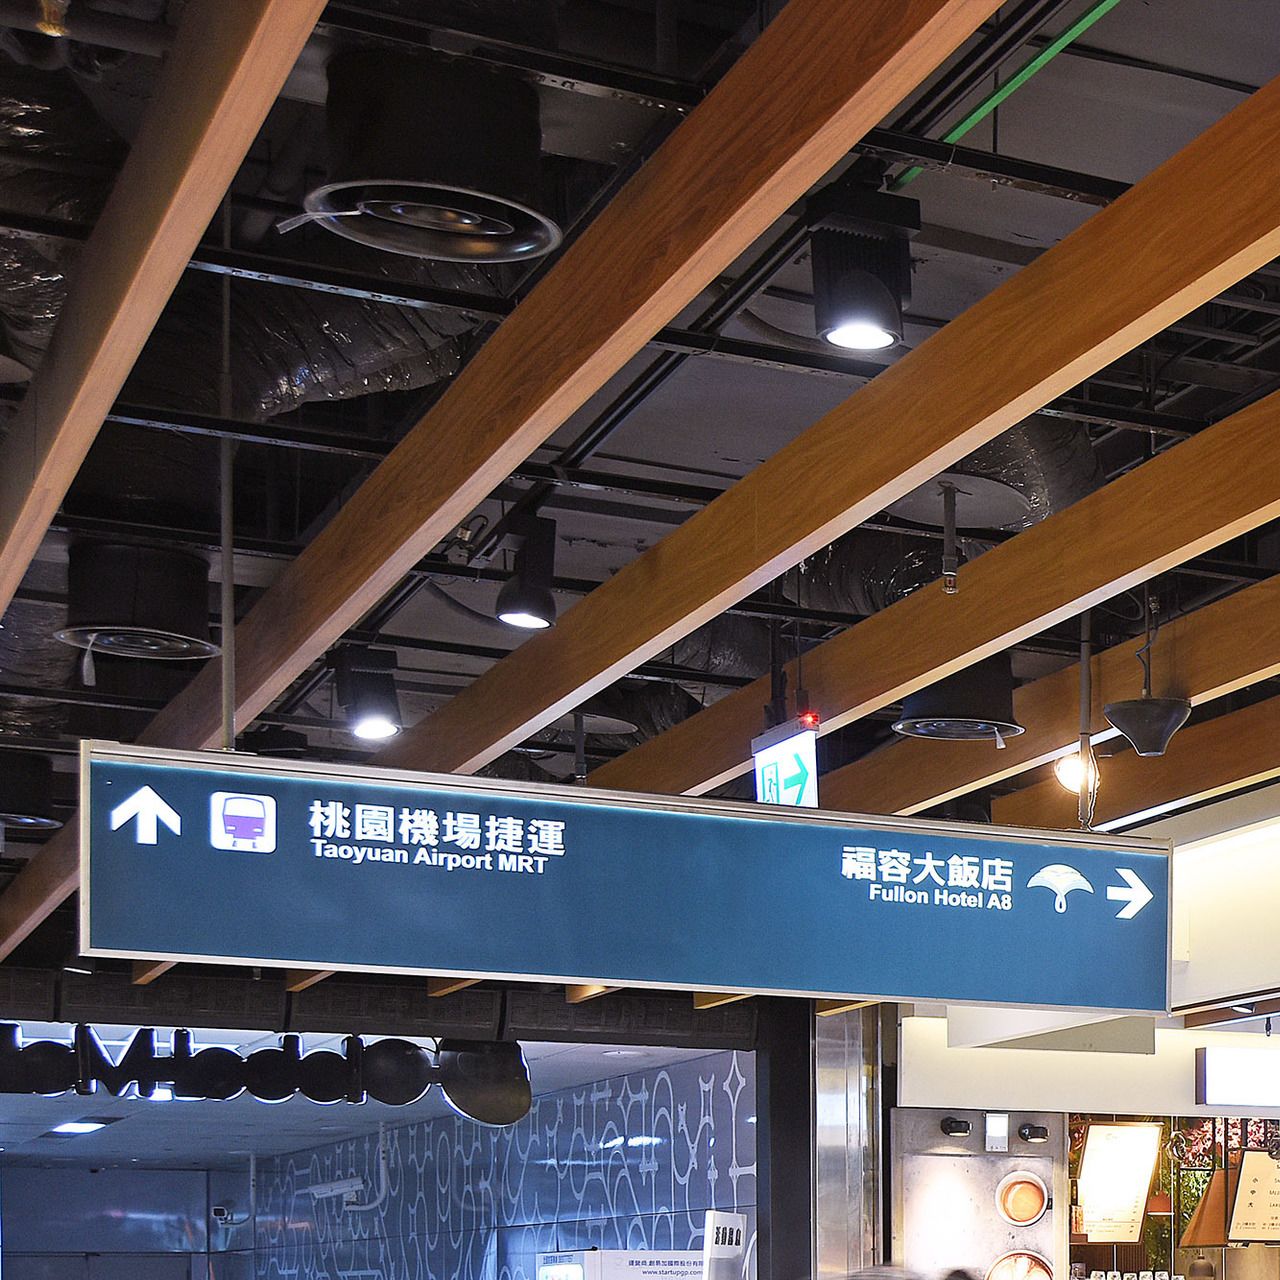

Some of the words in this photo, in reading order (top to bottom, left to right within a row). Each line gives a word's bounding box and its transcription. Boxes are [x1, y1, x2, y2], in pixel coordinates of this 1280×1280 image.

[308, 799, 567, 859] 桃園機場捷運
[311, 838, 409, 866] Taoyuan
[413, 846, 494, 874] Airport
[497, 853, 549, 875] MRT
[840, 845, 1014, 892] 福容大飯店
[868, 883, 929, 905] Fullon
[934, 887, 984, 908] Hotel
[986, 892, 1014, 911] A8
